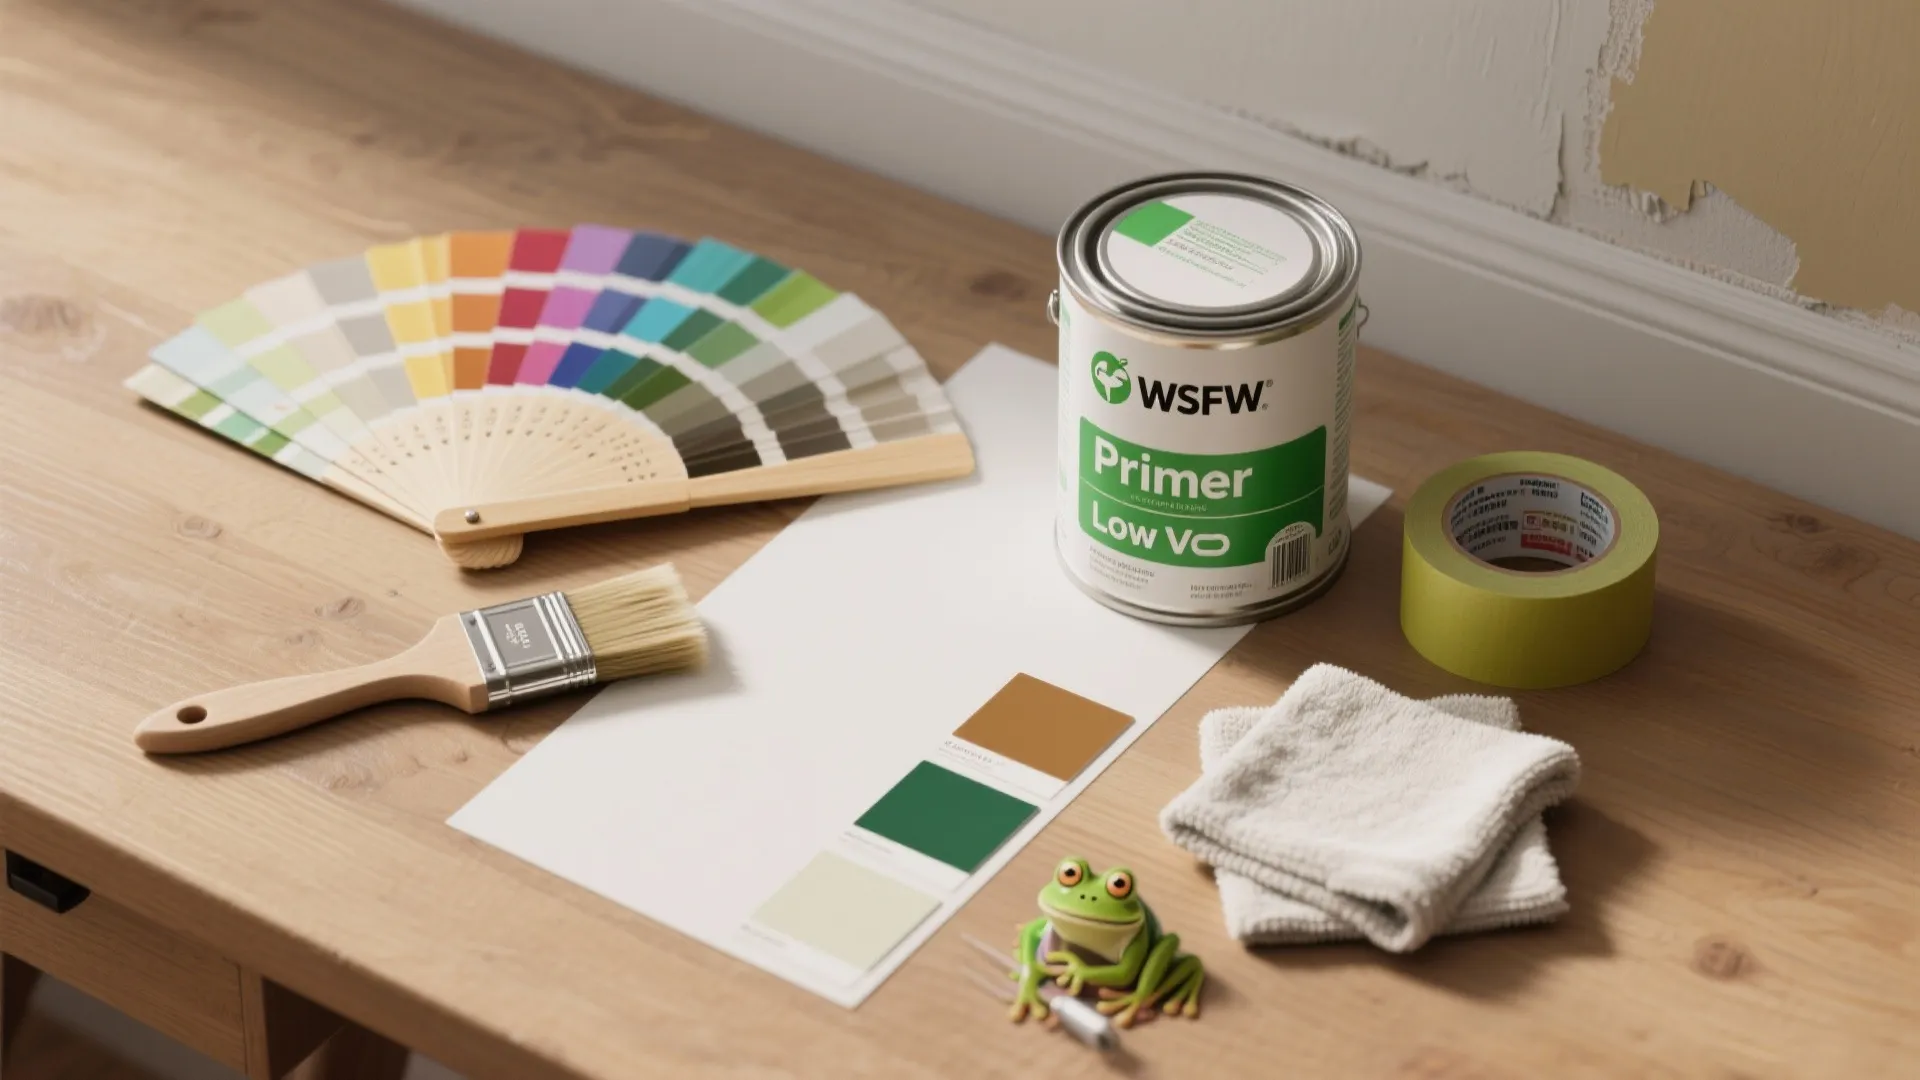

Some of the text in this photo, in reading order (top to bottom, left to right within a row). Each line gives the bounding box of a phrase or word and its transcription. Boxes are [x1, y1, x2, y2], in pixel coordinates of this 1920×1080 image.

[1138, 375, 1264, 415] WSFW
[1095, 435, 1253, 500] Primer
[1092, 500, 1158, 549] Low
